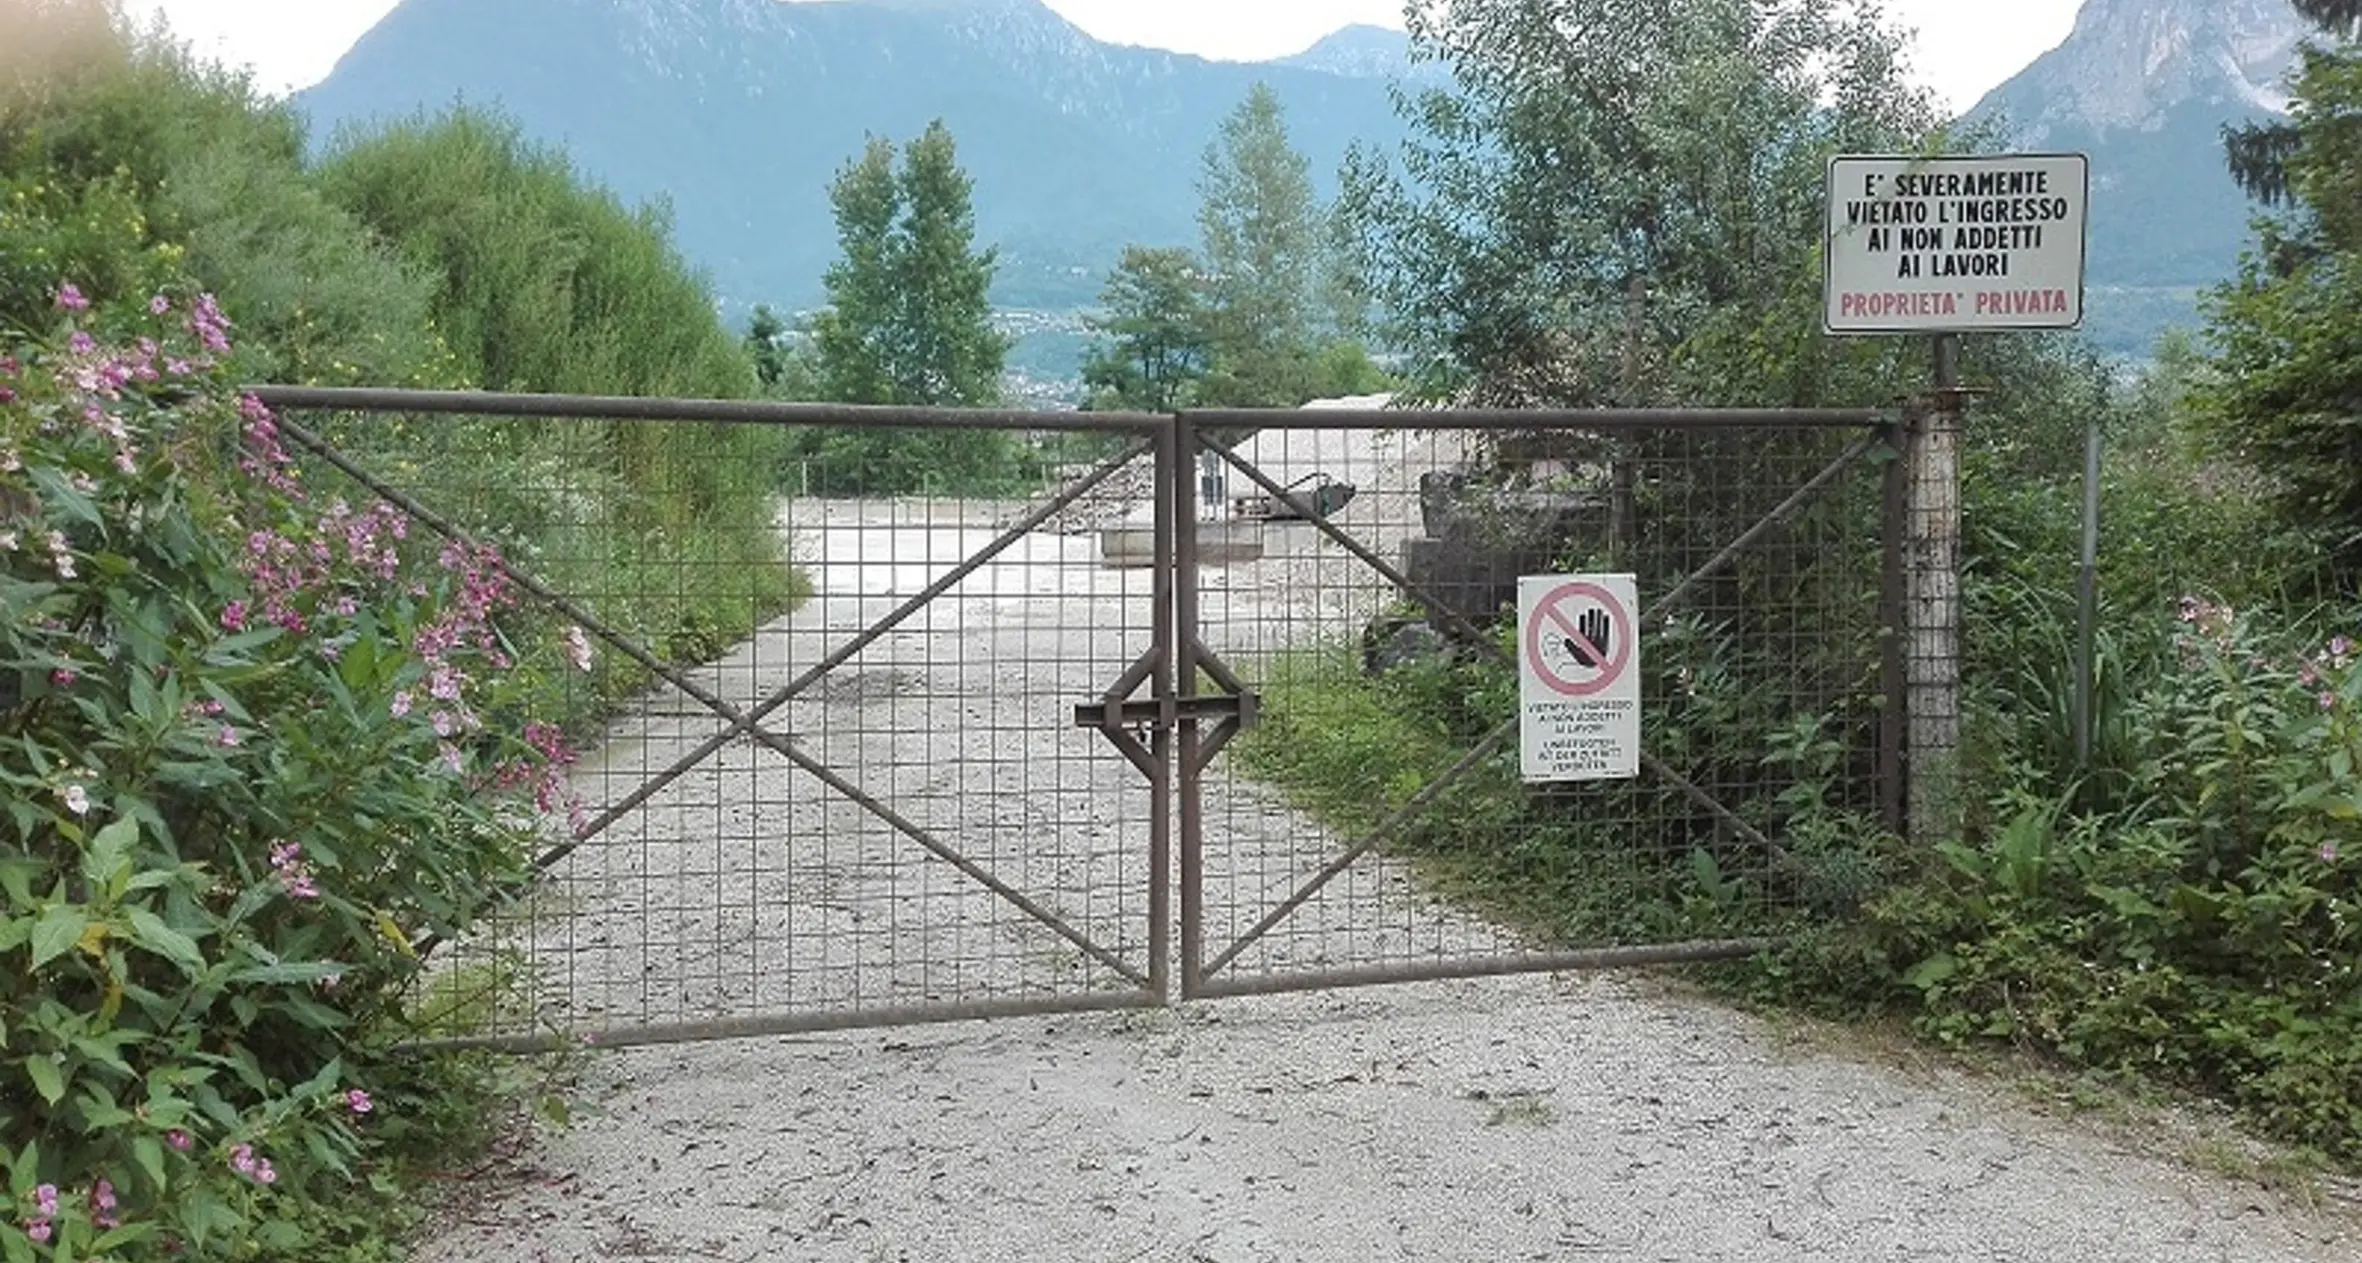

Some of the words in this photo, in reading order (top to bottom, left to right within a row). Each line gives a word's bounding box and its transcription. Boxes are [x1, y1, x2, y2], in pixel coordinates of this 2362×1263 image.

[1896, 171, 2047, 197] SEVERAMENTE
[1847, 201, 1927, 225] VIETATO
[1940, 198, 2068, 224] L'INGRESSO
[1868, 228, 1888, 252] AI
[1900, 228, 1943, 251] NON
[1954, 226, 2042, 250] ADDETTI
[1898, 255, 1920, 278] AI
[1931, 253, 2008, 277] LAVORI
[1976, 290, 2067, 315] PRIVATA
[1571, 700, 1633, 711] NGRESSO
[1580, 748, 1622, 761] ZTTT
